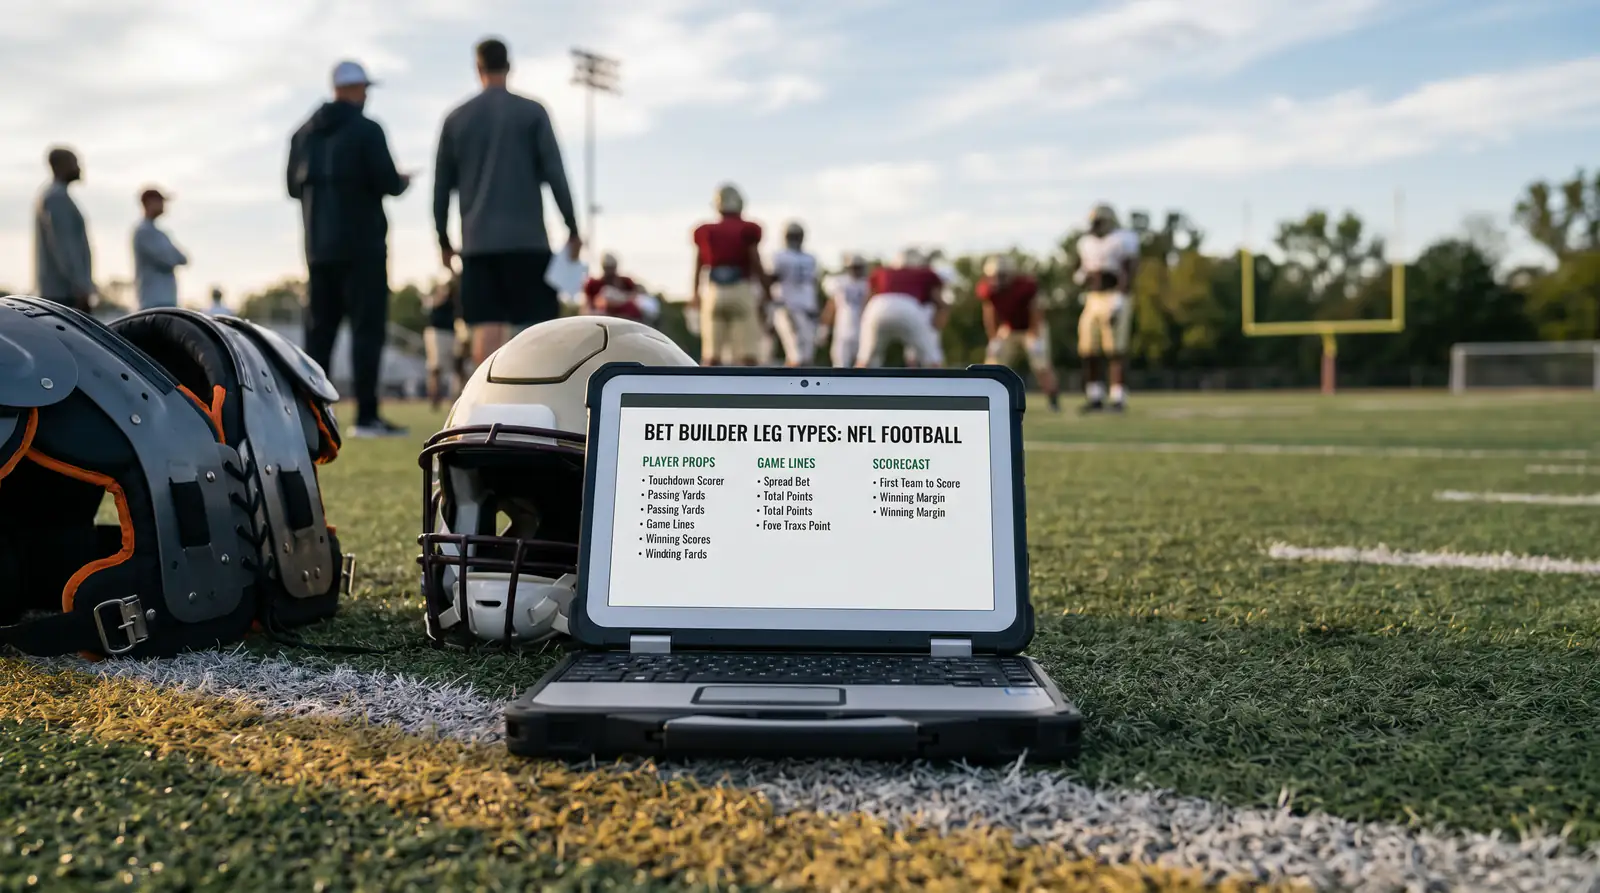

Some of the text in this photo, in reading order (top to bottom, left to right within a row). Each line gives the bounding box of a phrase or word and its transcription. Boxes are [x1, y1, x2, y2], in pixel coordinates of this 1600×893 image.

[645, 423, 963, 444] BET BUILDER LEG TYPES: NFL FOOTBALL
[643, 456, 716, 468] PLAYER PROPS
[758, 457, 816, 469] GAME LINES
[873, 459, 931, 470] SCORECAST
[649, 474, 725, 486] Touchdown Scorer
[764, 476, 811, 488] Spread Bet
[880, 477, 961, 489] First Team to Score
[648, 489, 706, 502] Passing Yards
[764, 491, 814, 502] Total Points
[880, 492, 946, 505] Winning Margin
[647, 504, 706, 517] Passing Yards
[763, 505, 813, 516] Total Points
[880, 507, 946, 520] Winning Margin
[646, 518, 695, 530] Game Lines
[784, 520, 807, 531] Traxs
[808, 520, 832, 531] Point
[646, 533, 711, 546] Winning Scores
[684, 549, 708, 560] Fards
